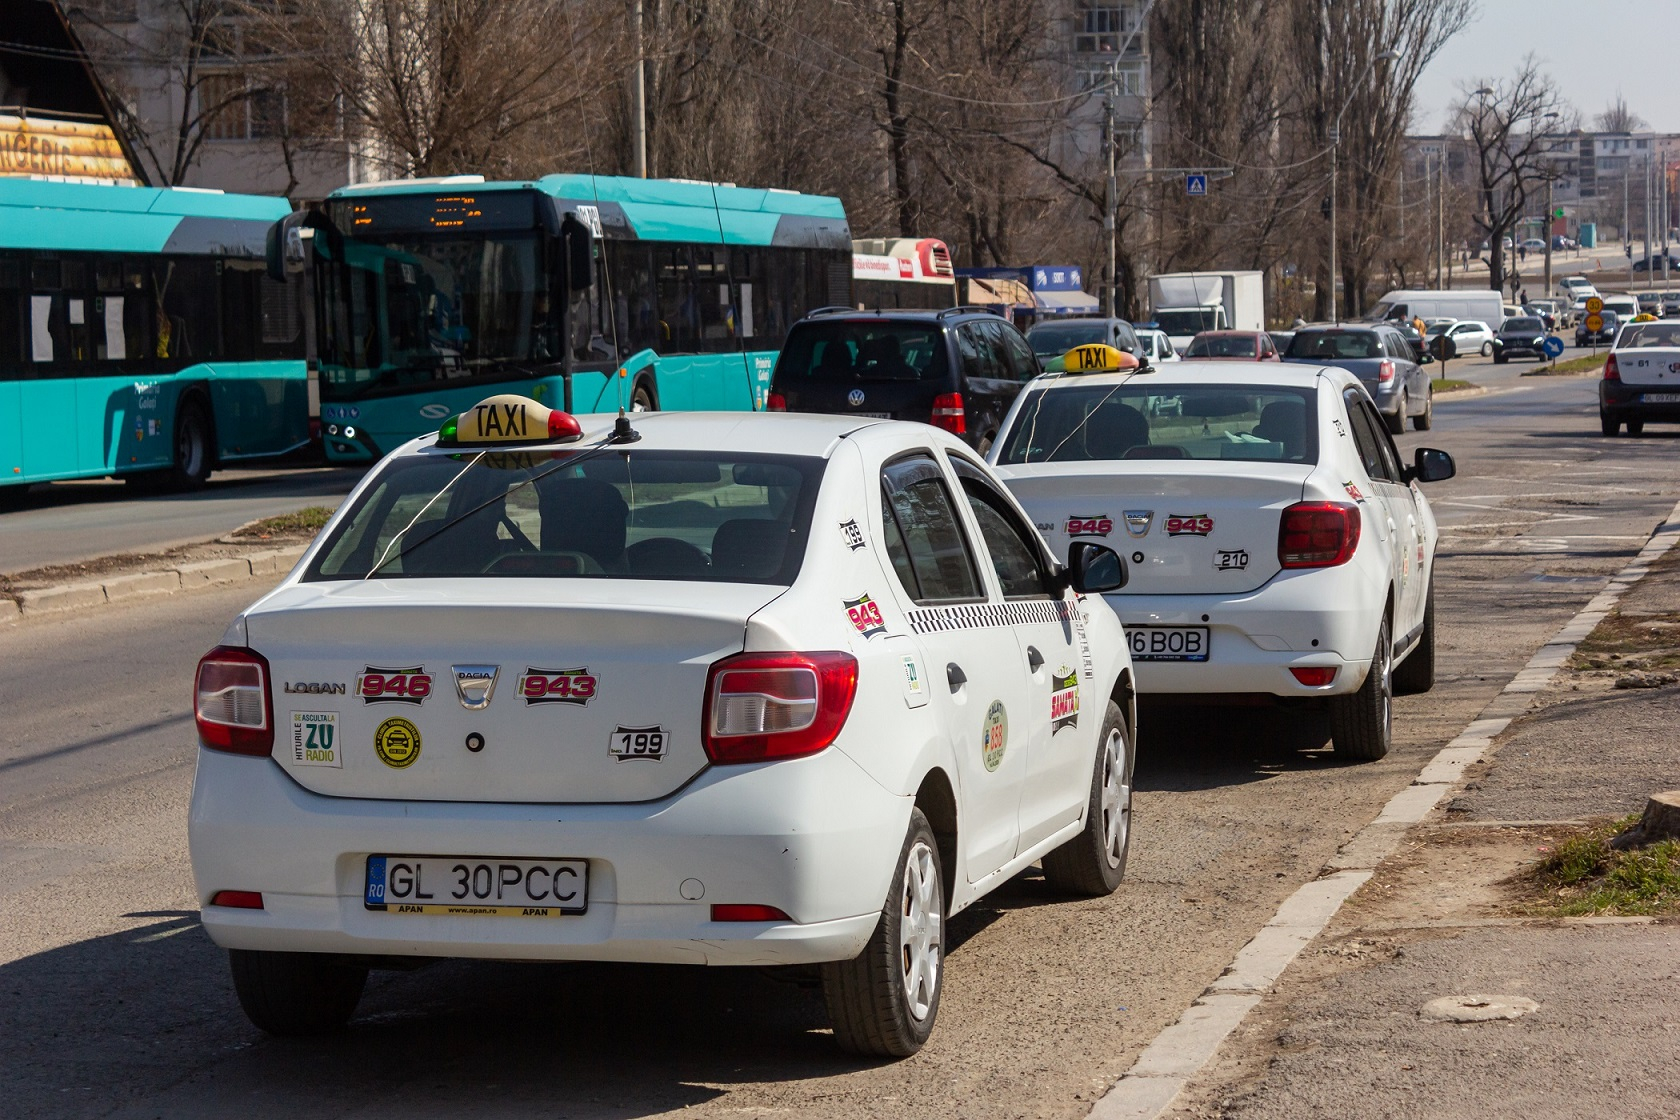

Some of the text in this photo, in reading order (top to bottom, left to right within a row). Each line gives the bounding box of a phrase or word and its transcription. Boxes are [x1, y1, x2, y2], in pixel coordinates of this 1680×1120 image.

[1076, 348, 1107, 369] TAXI
[475, 404, 526, 436] TAXI
[845, 524, 862, 544] 199
[1067, 519, 1113, 533] 946
[1167, 518, 1213, 533] 943
[1222, 553, 1249, 566] 210
[848, 601, 885, 632] 943
[284, 682, 346, 695] LOGAN
[362, 674, 432, 697] 946
[524, 676, 597, 698] 943
[302, 714, 327, 722] ASCULTA
[294, 723, 303, 760] HITURILE
[305, 723, 335, 749] ZU
[622, 733, 663, 754] 199
[306, 750, 334, 762] RADIO
[368, 884, 384, 898] RO
[390, 863, 434, 899] GL
[398, 905, 423, 913] APAN
[522, 908, 548, 916] APAN
